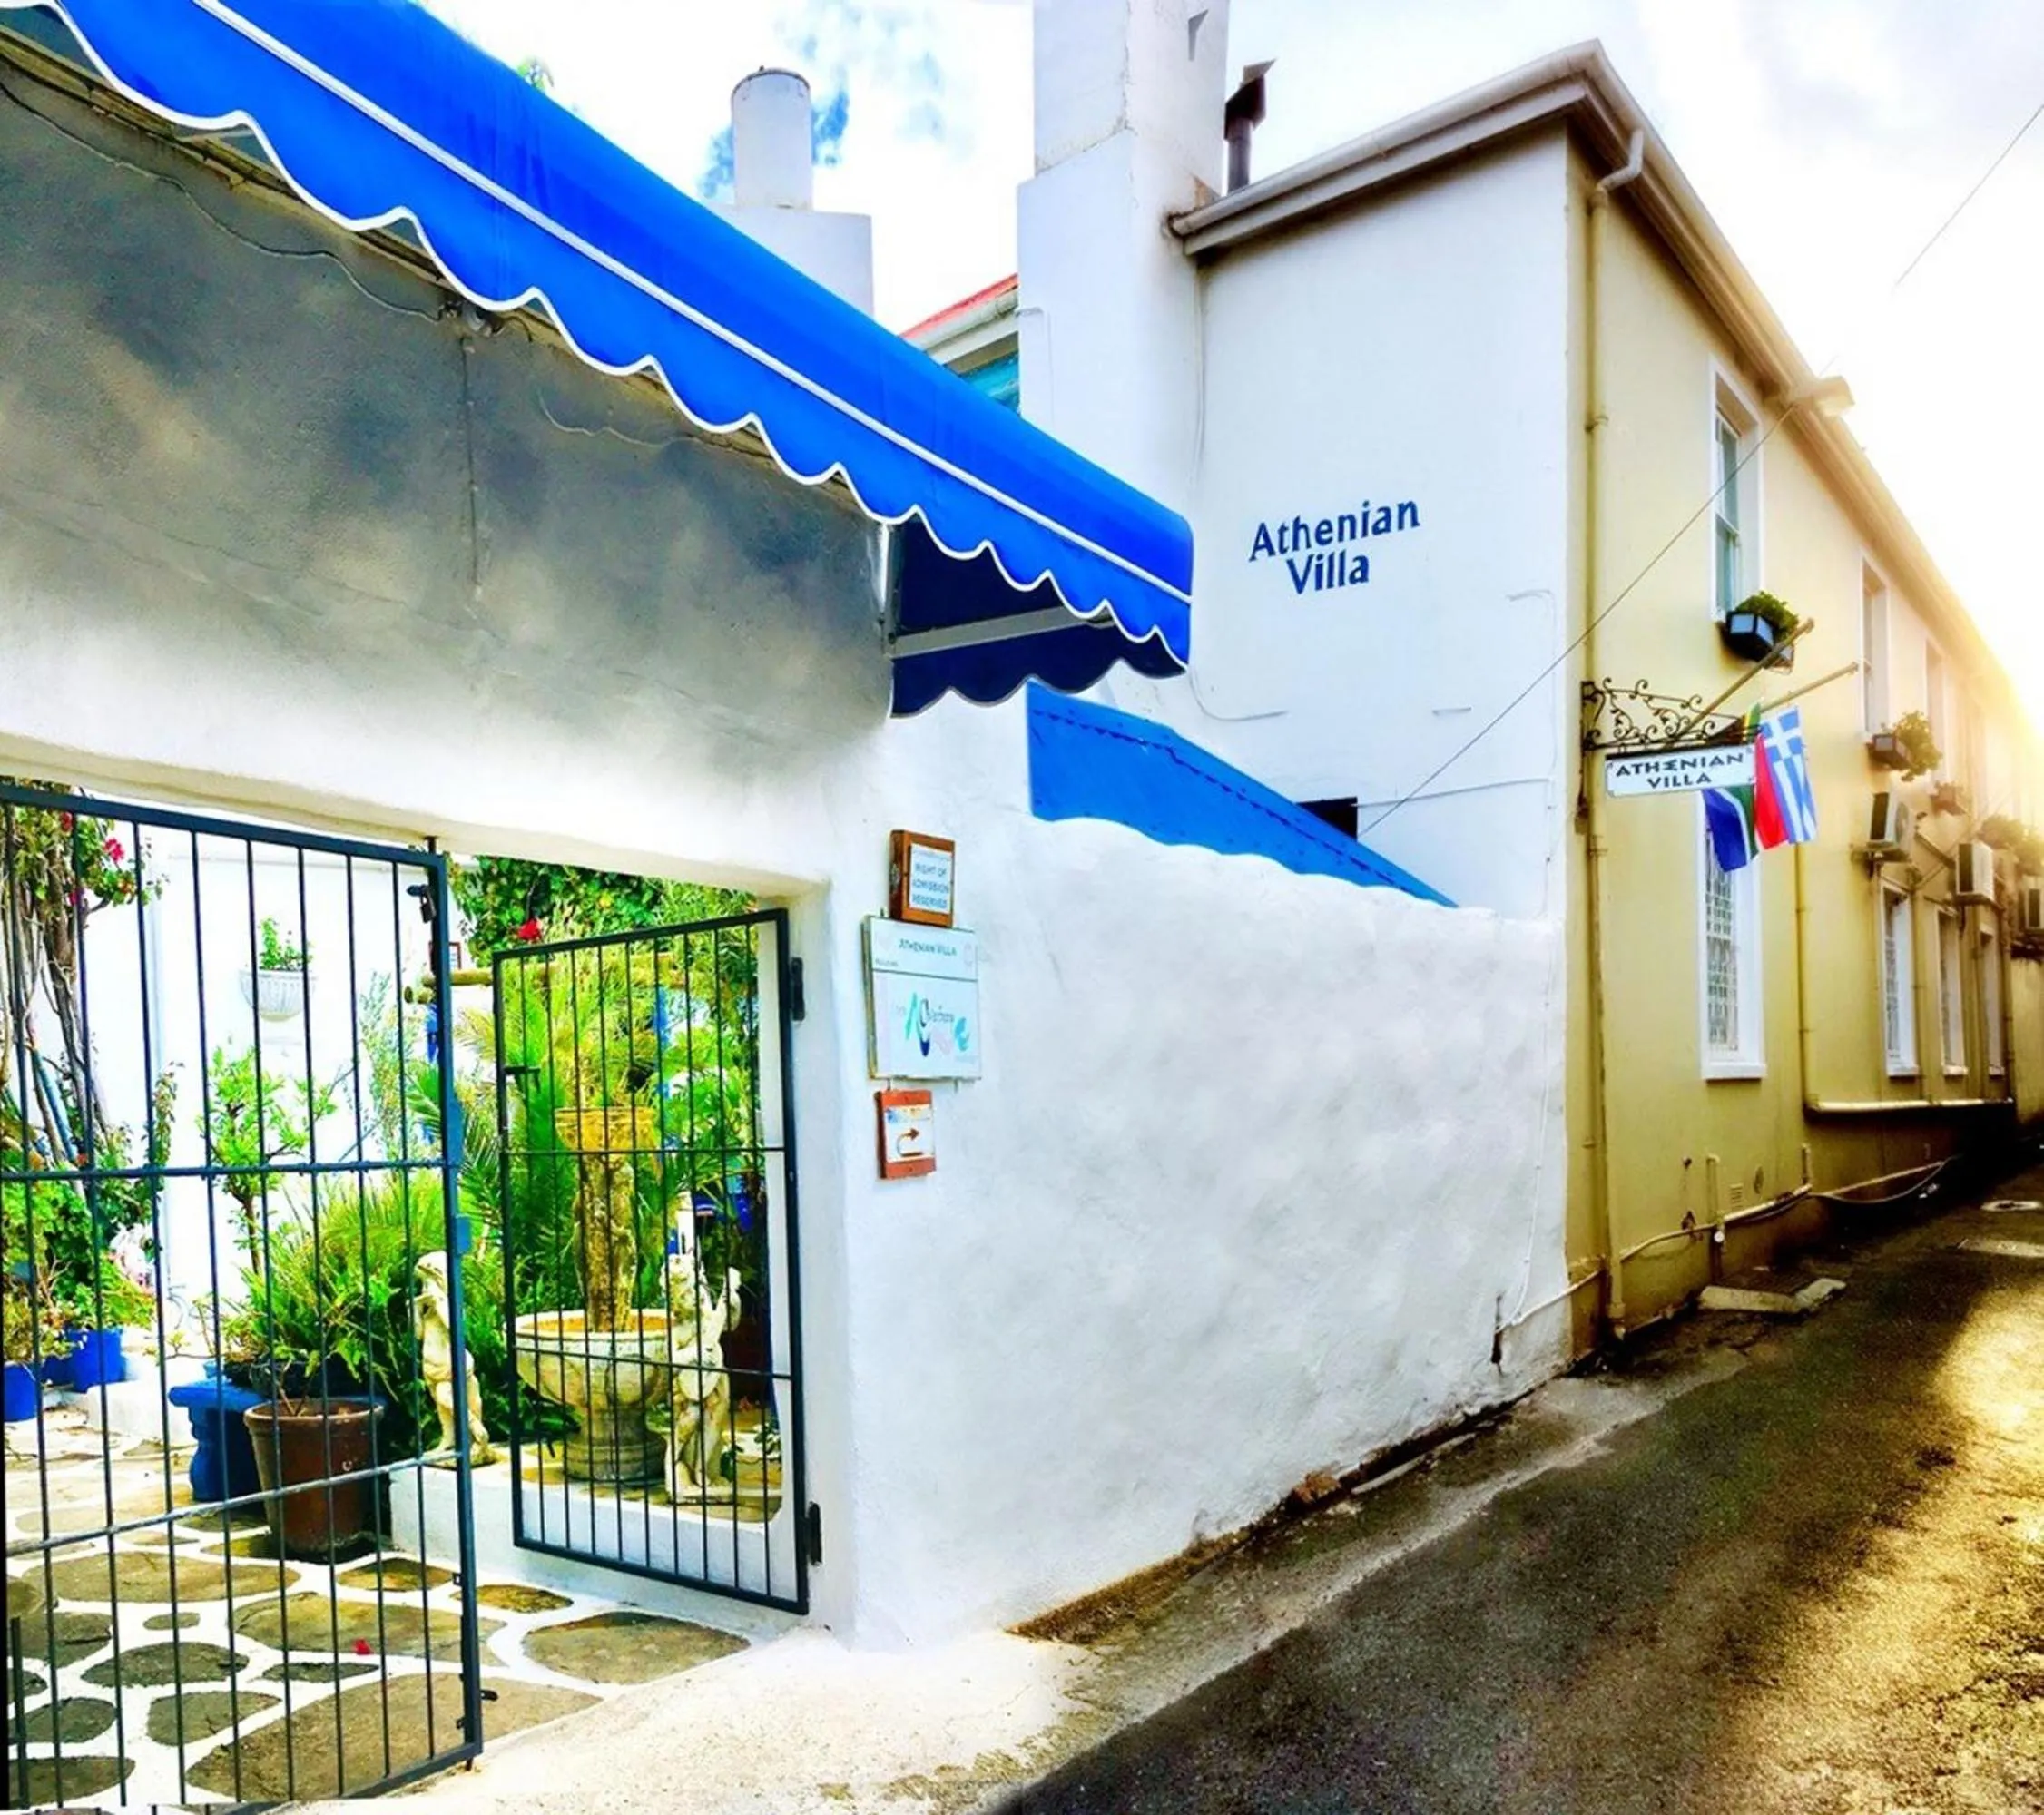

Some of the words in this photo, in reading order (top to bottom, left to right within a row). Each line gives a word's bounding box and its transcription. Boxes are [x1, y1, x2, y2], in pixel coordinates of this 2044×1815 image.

[1249, 500, 1420, 563] Athenian
[1286, 549, 1370, 594] Villa
[1647, 772, 1712, 790] VILLA
[915, 863, 936, 876] RIGHT
[938, 868, 947, 878] OF
[938, 944, 957, 957] VILLA
